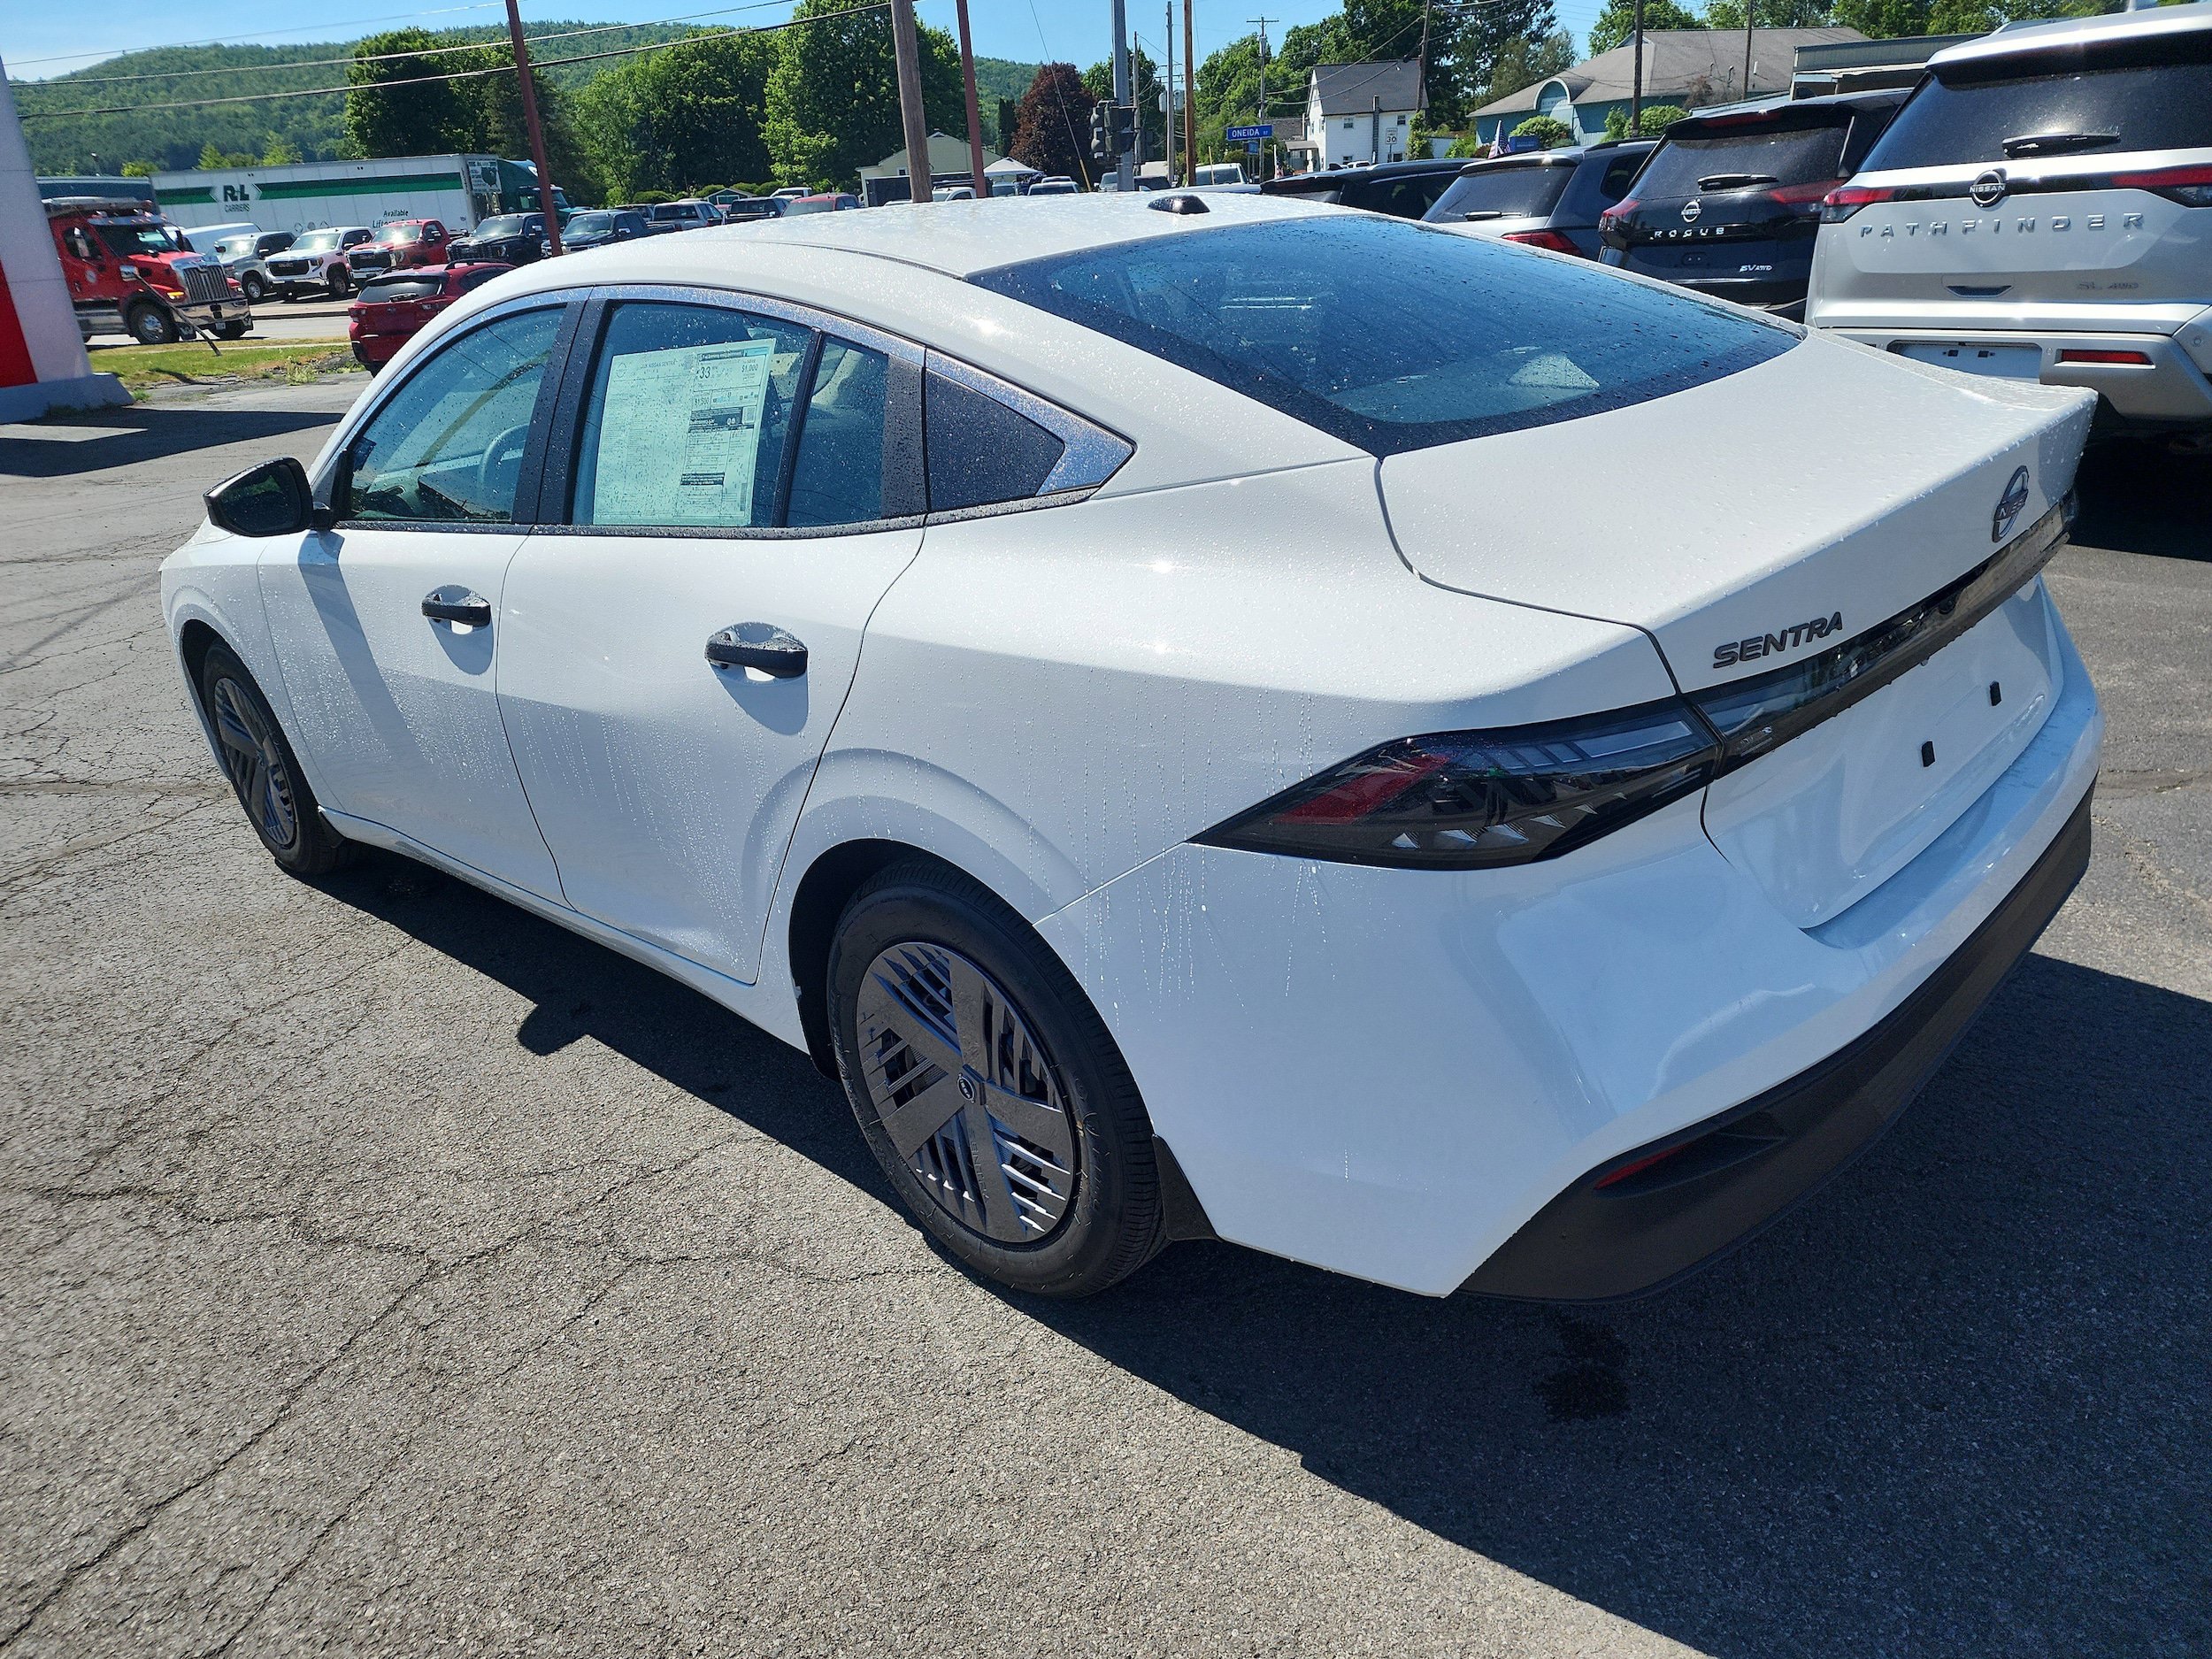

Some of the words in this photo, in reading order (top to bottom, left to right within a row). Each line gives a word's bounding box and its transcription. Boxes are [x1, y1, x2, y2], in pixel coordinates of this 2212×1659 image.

[1232, 128, 1260, 137] ONEIDA
[1970, 182, 2006, 193] NISSAN
[1860, 212, 2144, 238] PATHFINDER
[1654, 227, 1724, 237] ROGUE
[699, 366, 711, 379] 33
[1713, 611, 1843, 669] SENTRA
